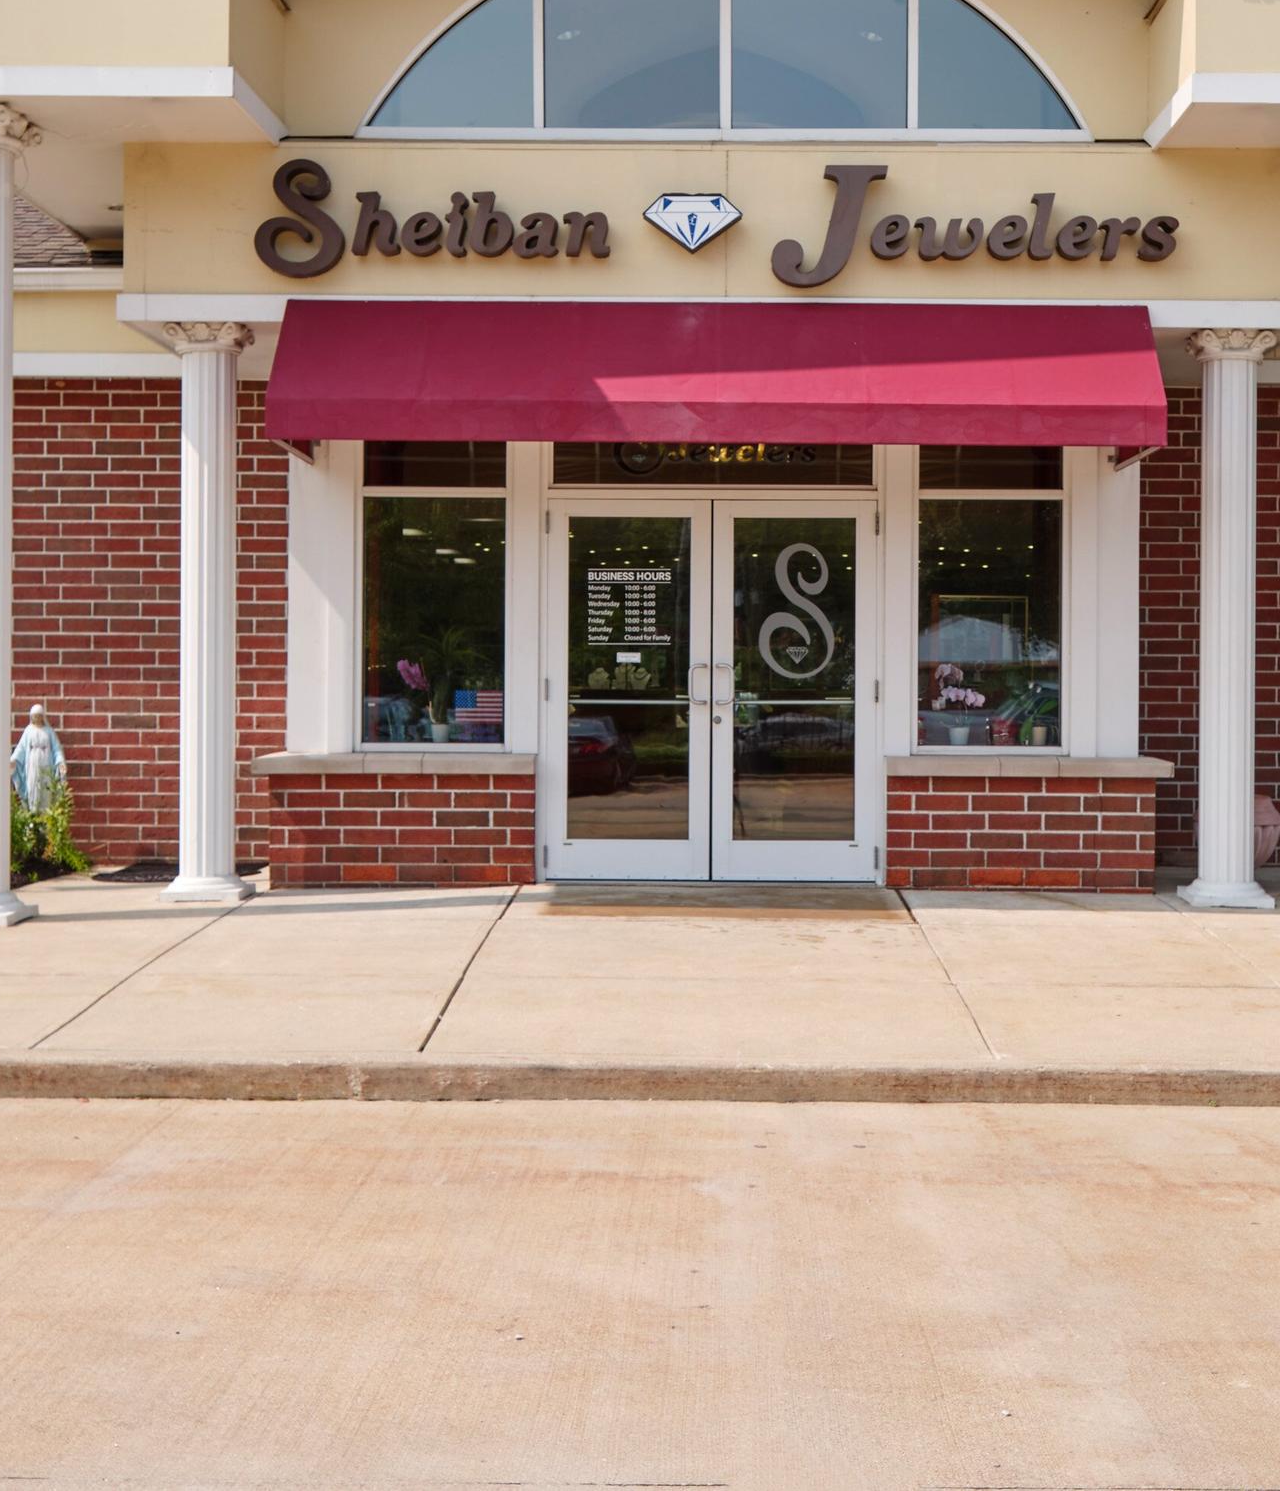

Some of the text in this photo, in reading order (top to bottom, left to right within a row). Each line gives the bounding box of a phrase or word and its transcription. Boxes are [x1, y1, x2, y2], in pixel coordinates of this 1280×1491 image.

[254, 158, 1180, 289] Sheiban Jewelers
[587, 571, 672, 581] BUSINESS HOURS
[587, 634, 610, 642] Sunday
[652, 634, 671, 642] Family
